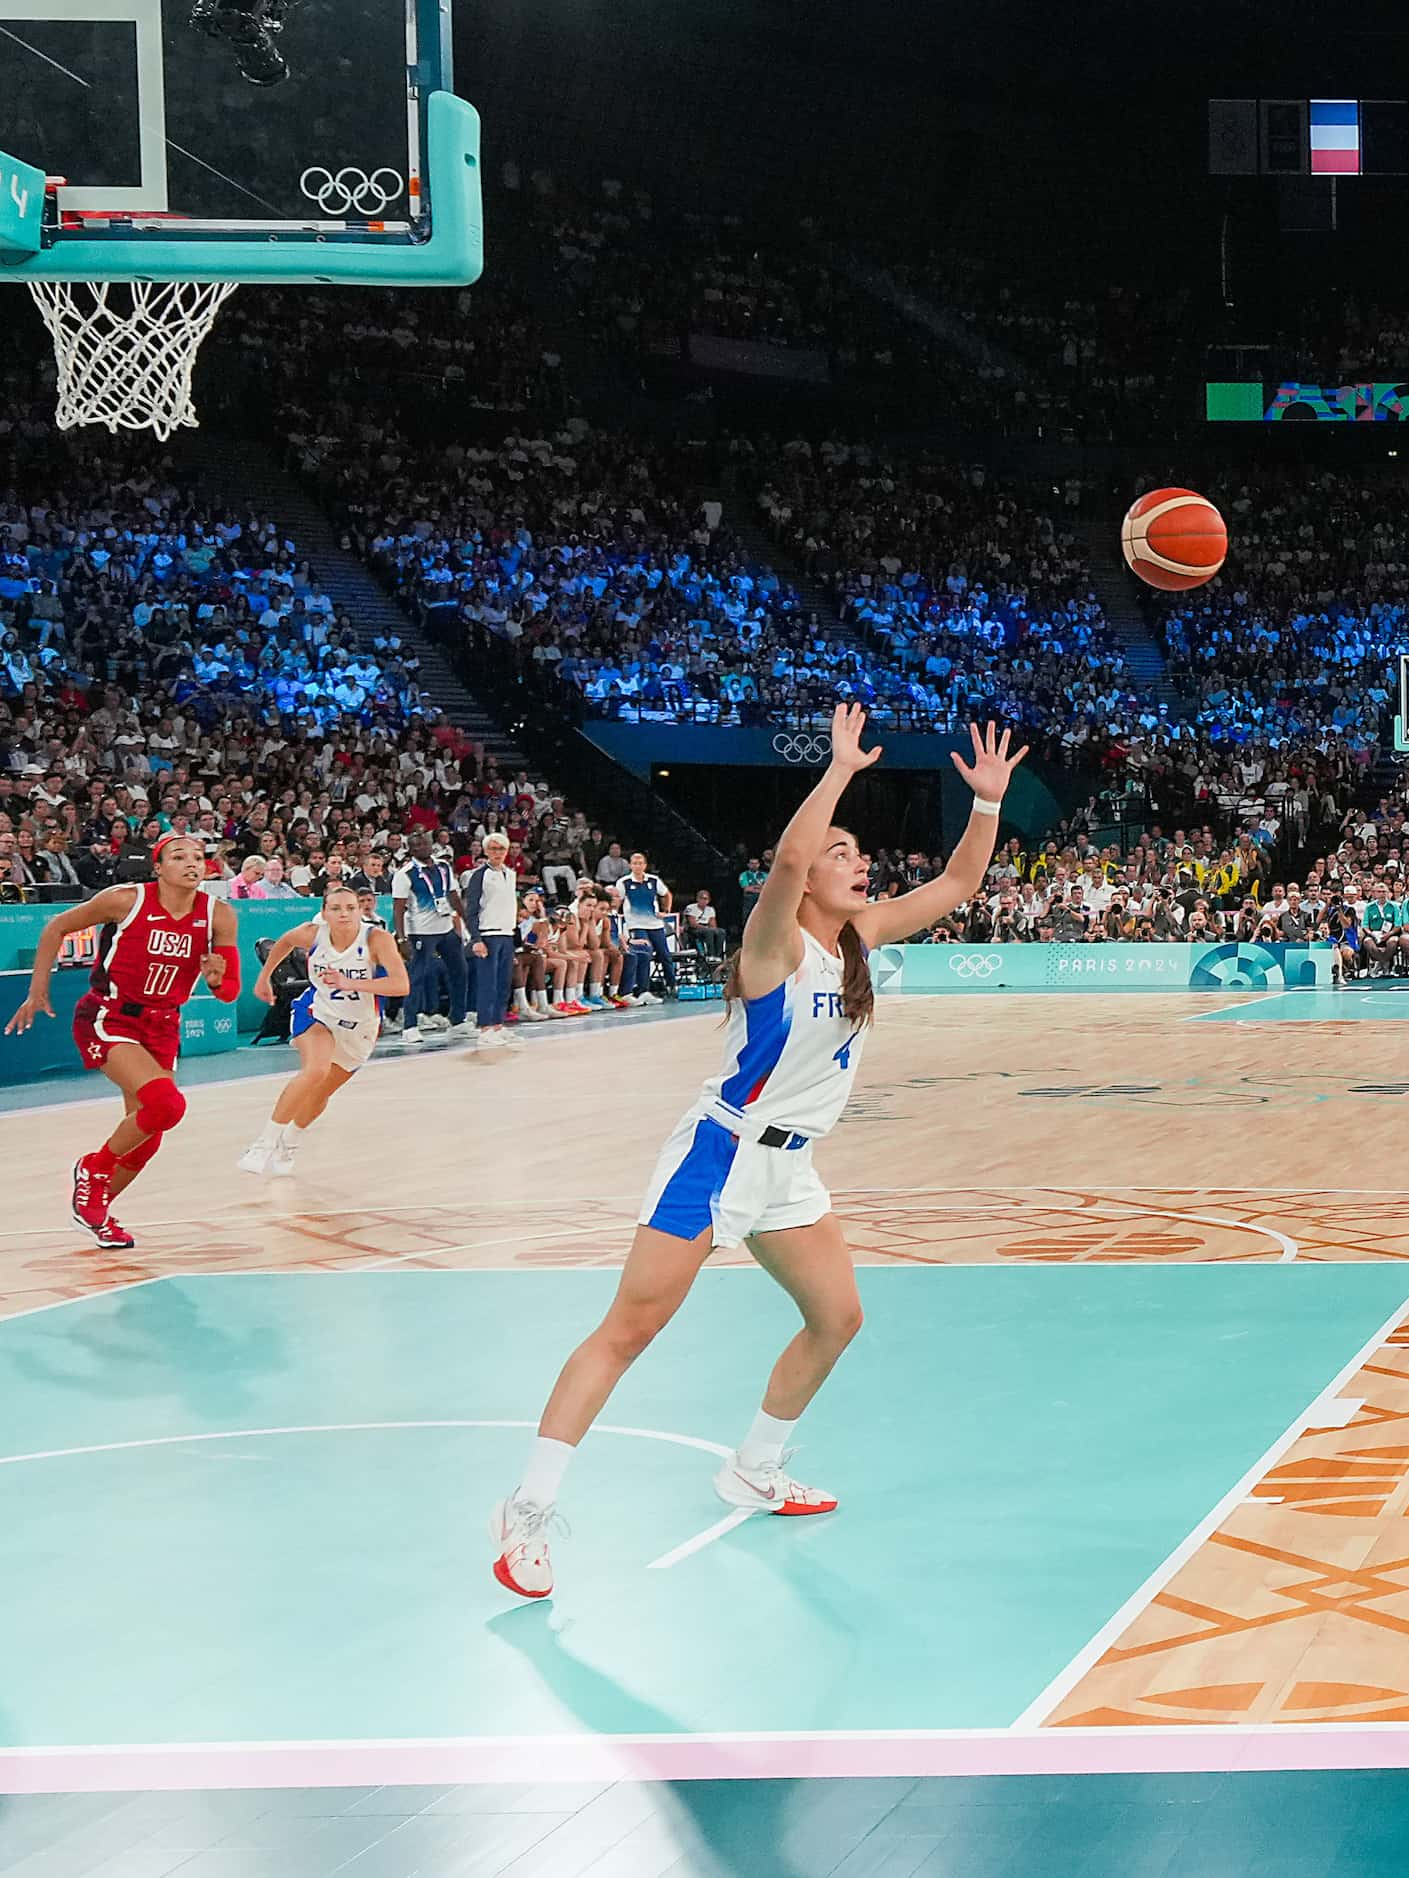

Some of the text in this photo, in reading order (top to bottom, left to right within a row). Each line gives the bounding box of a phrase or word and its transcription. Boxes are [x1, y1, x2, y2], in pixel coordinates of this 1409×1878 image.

[147, 929, 193, 958] USA
[144, 963, 179, 995] 11
[1059, 959, 1178, 972] PARIS 2024
[832, 1033, 858, 1070] 4
